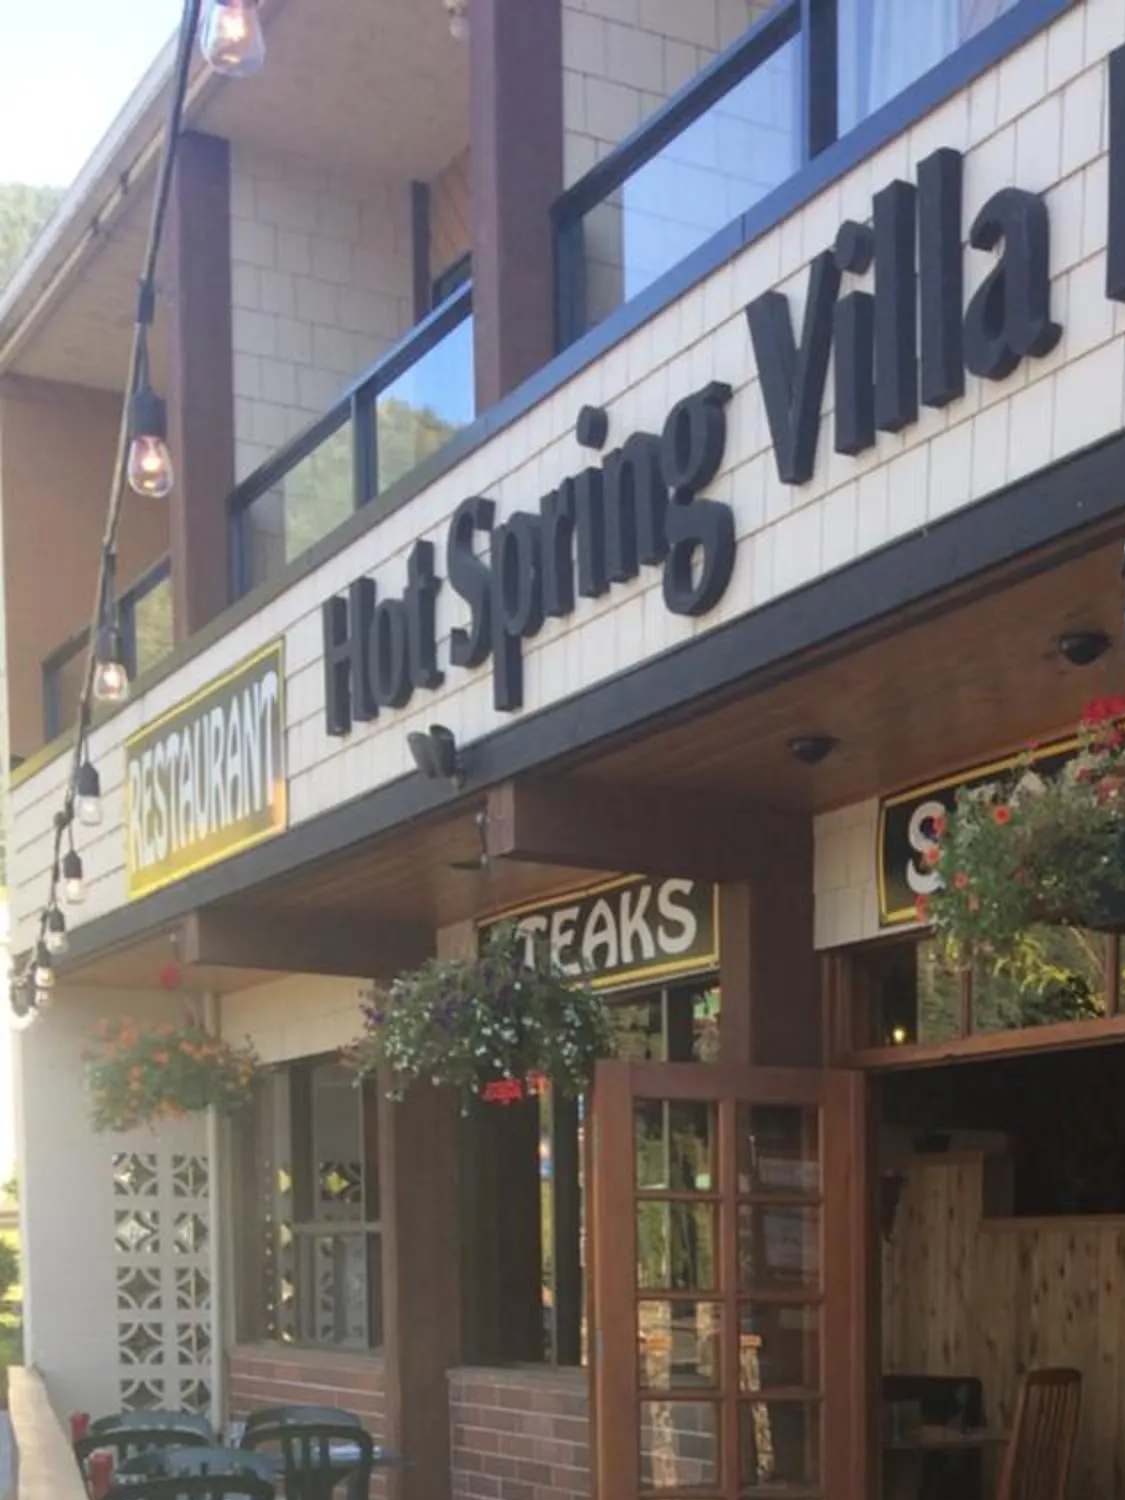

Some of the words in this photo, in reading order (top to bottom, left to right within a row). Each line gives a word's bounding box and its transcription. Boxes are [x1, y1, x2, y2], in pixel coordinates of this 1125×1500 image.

[322, 538, 445, 737] Hot
[447, 380, 737, 712] Spring
[746, 146, 1064, 486] Villa
[129, 670, 278, 873] RESTAURANT
[488, 878, 698, 977] TEAKS
